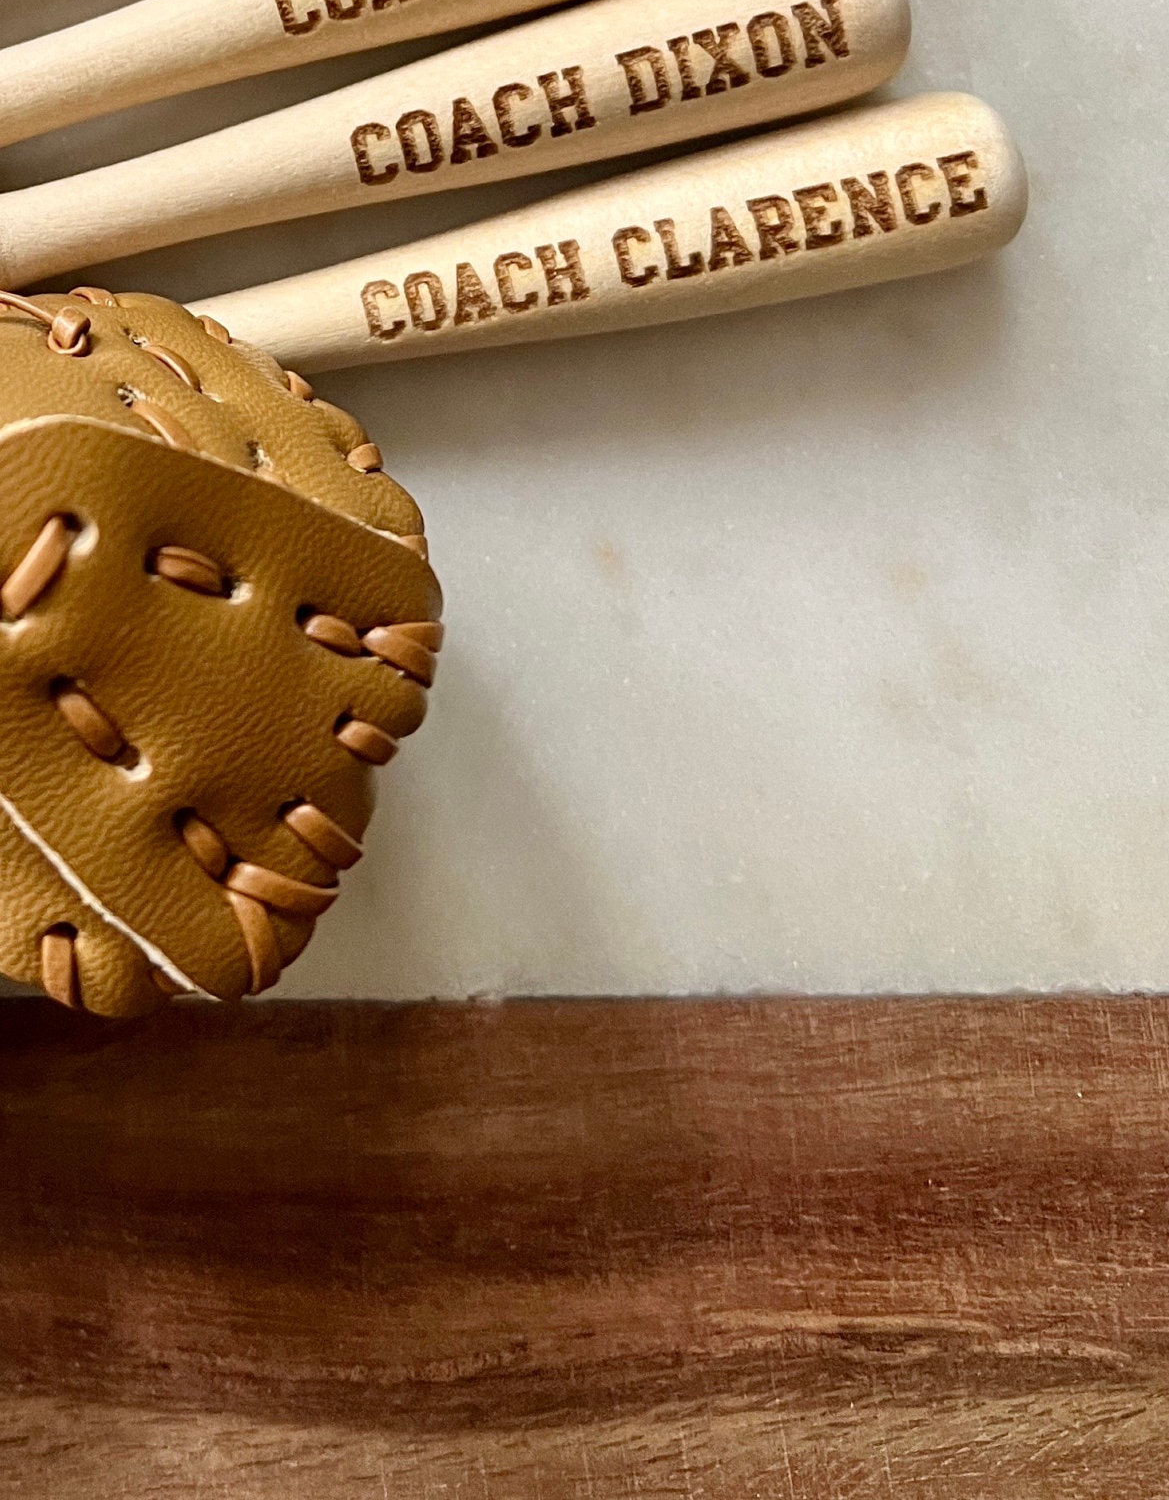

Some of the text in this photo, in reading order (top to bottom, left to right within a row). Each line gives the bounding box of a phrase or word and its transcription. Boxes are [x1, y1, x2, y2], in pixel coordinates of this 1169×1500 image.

[349, 65, 596, 186] COACH
[360, 150, 989, 339] COACH CLARENCE
